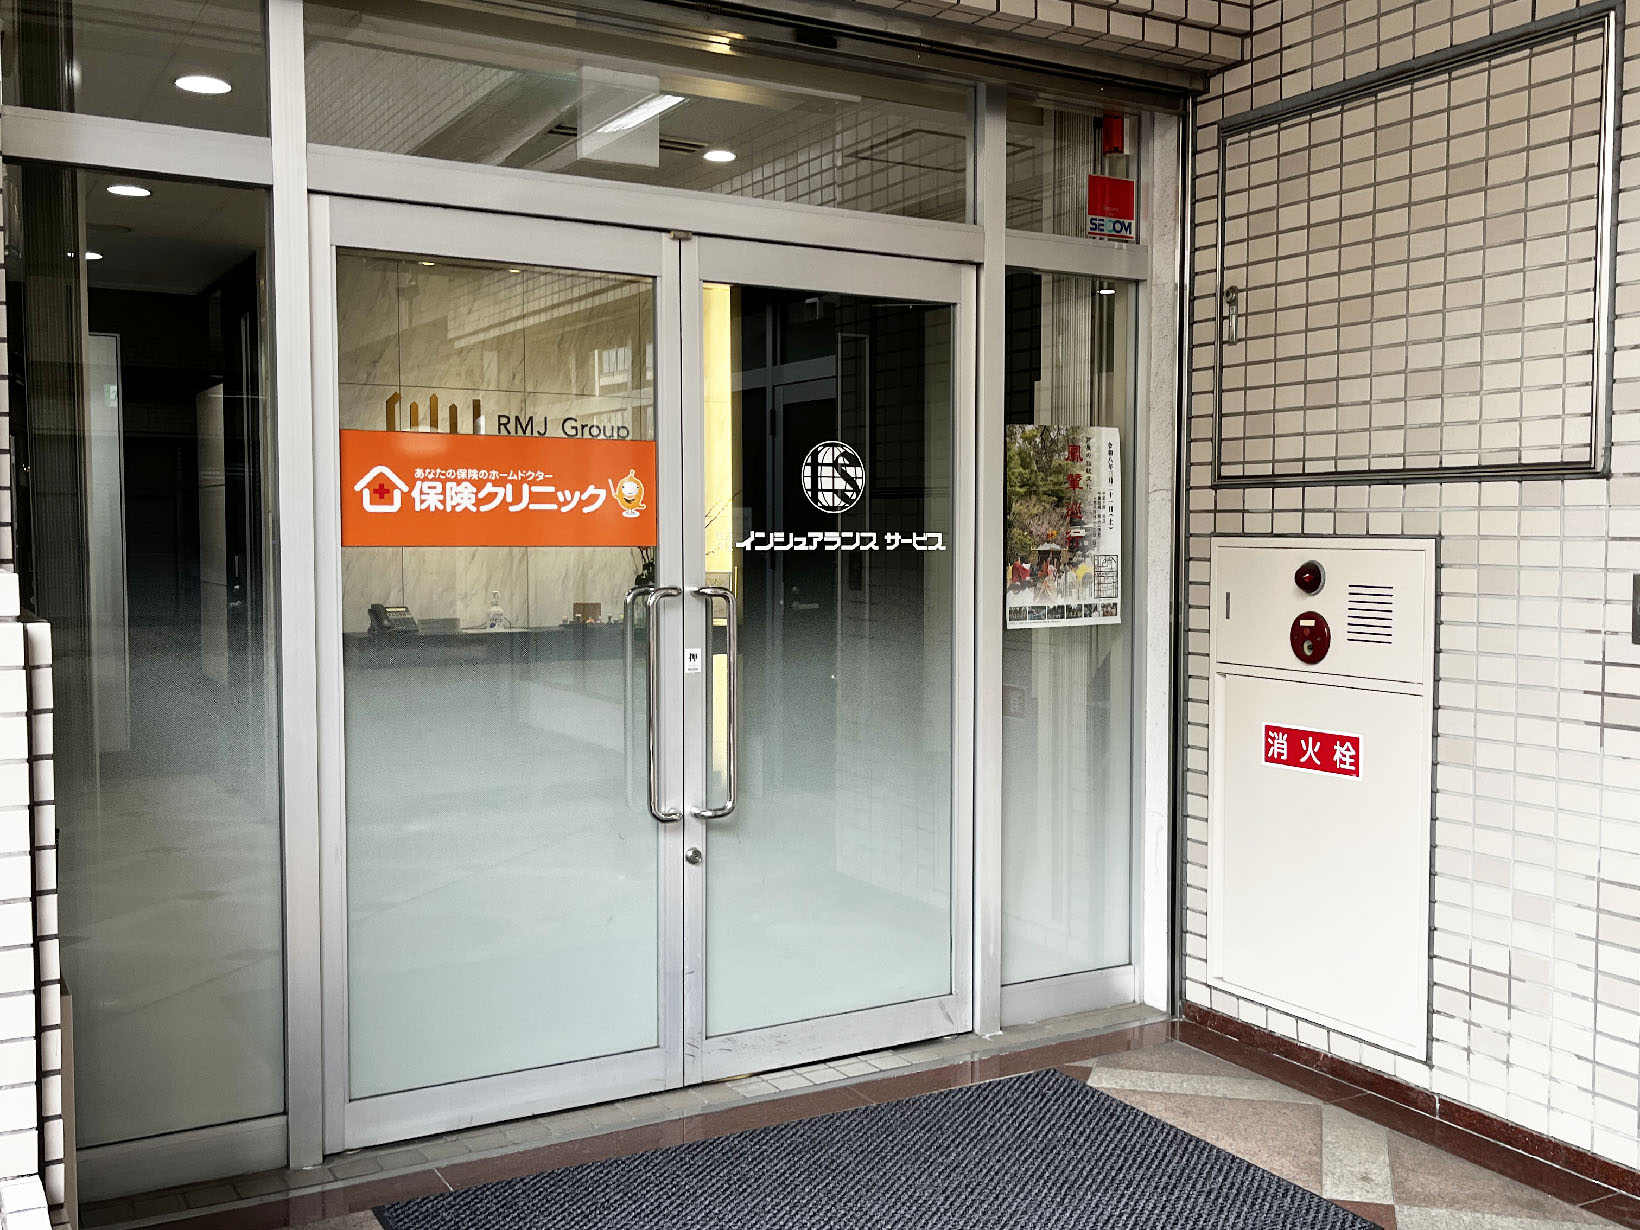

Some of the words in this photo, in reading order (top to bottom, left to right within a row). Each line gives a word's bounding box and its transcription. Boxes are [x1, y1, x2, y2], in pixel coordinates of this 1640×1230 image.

[1089, 217, 1132, 234] SECOM
[497, 414, 548, 437] RMJ
[561, 417, 630, 440] Group
[414, 467, 554, 482] あなたの保険のホームドクター
[410, 481, 607, 514] 保険クリニック
[735, 531, 880, 551] インシュアランス
[884, 532, 947, 551] サービス
[1267, 730, 1356, 770] 消火栓
